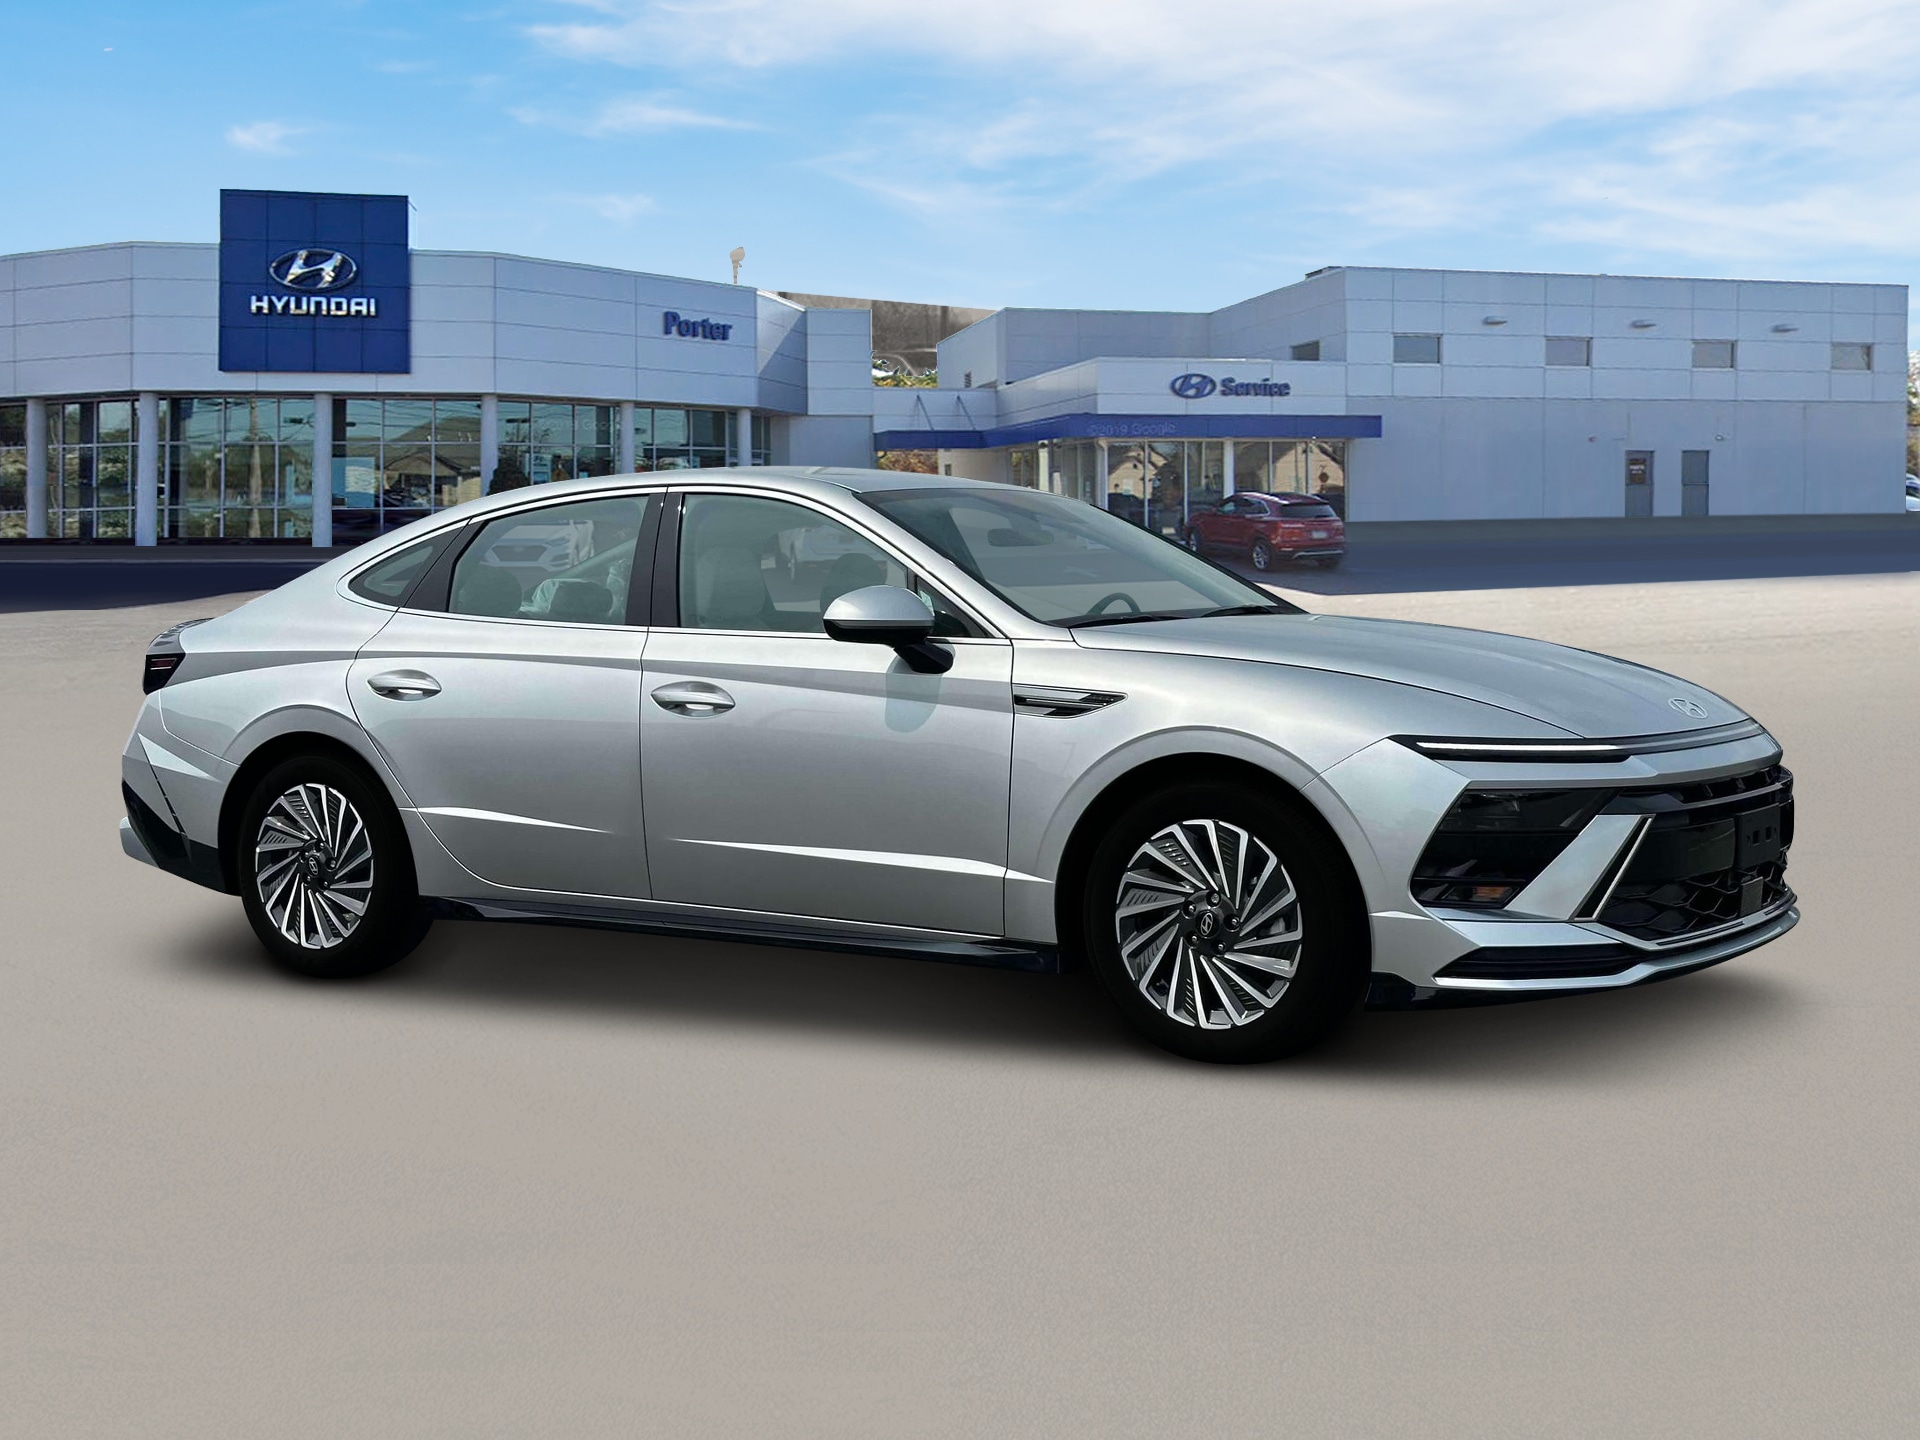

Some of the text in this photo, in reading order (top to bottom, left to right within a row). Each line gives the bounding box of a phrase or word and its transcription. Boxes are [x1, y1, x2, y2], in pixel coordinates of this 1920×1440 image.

[250, 295, 377, 317] HYUNDAI
[663, 311, 733, 341] Porter
[1219, 377, 1291, 397] Service
